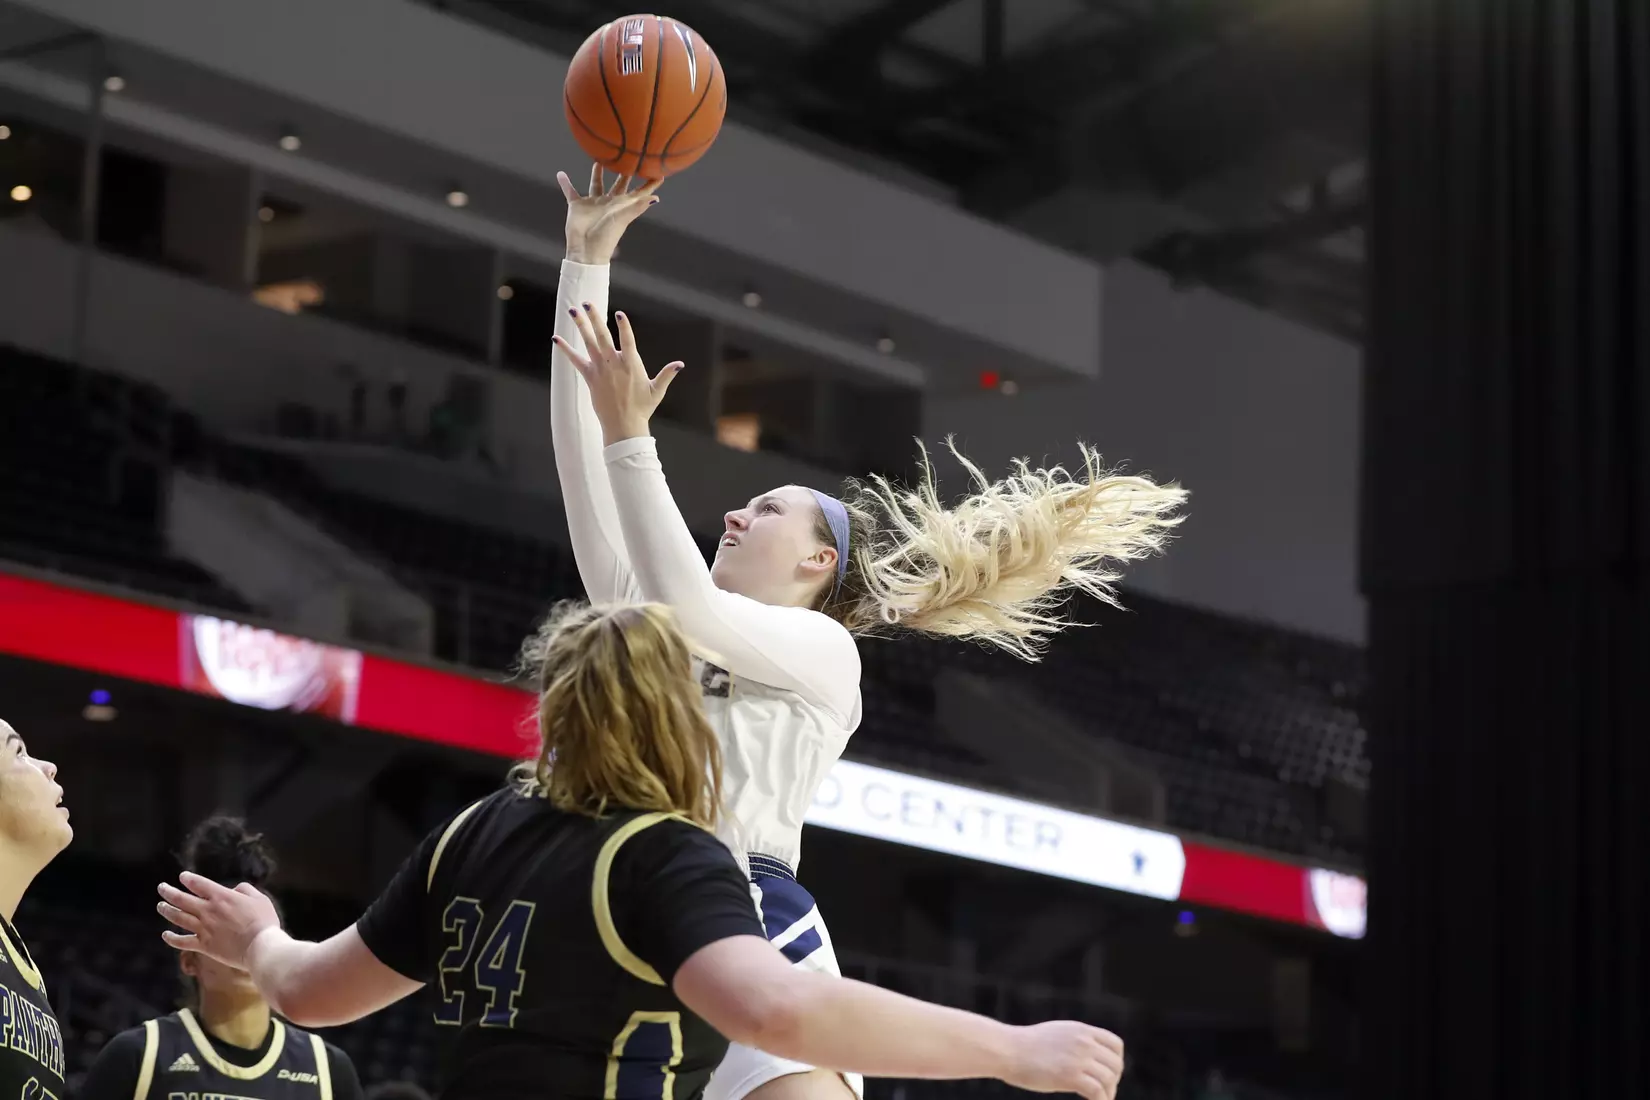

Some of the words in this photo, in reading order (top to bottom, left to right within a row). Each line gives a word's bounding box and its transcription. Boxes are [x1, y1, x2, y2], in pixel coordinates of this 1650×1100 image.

[857, 781, 1064, 853] CENTER
[433, 896, 536, 1028] 24
[0, 983, 65, 1083] PANTH
